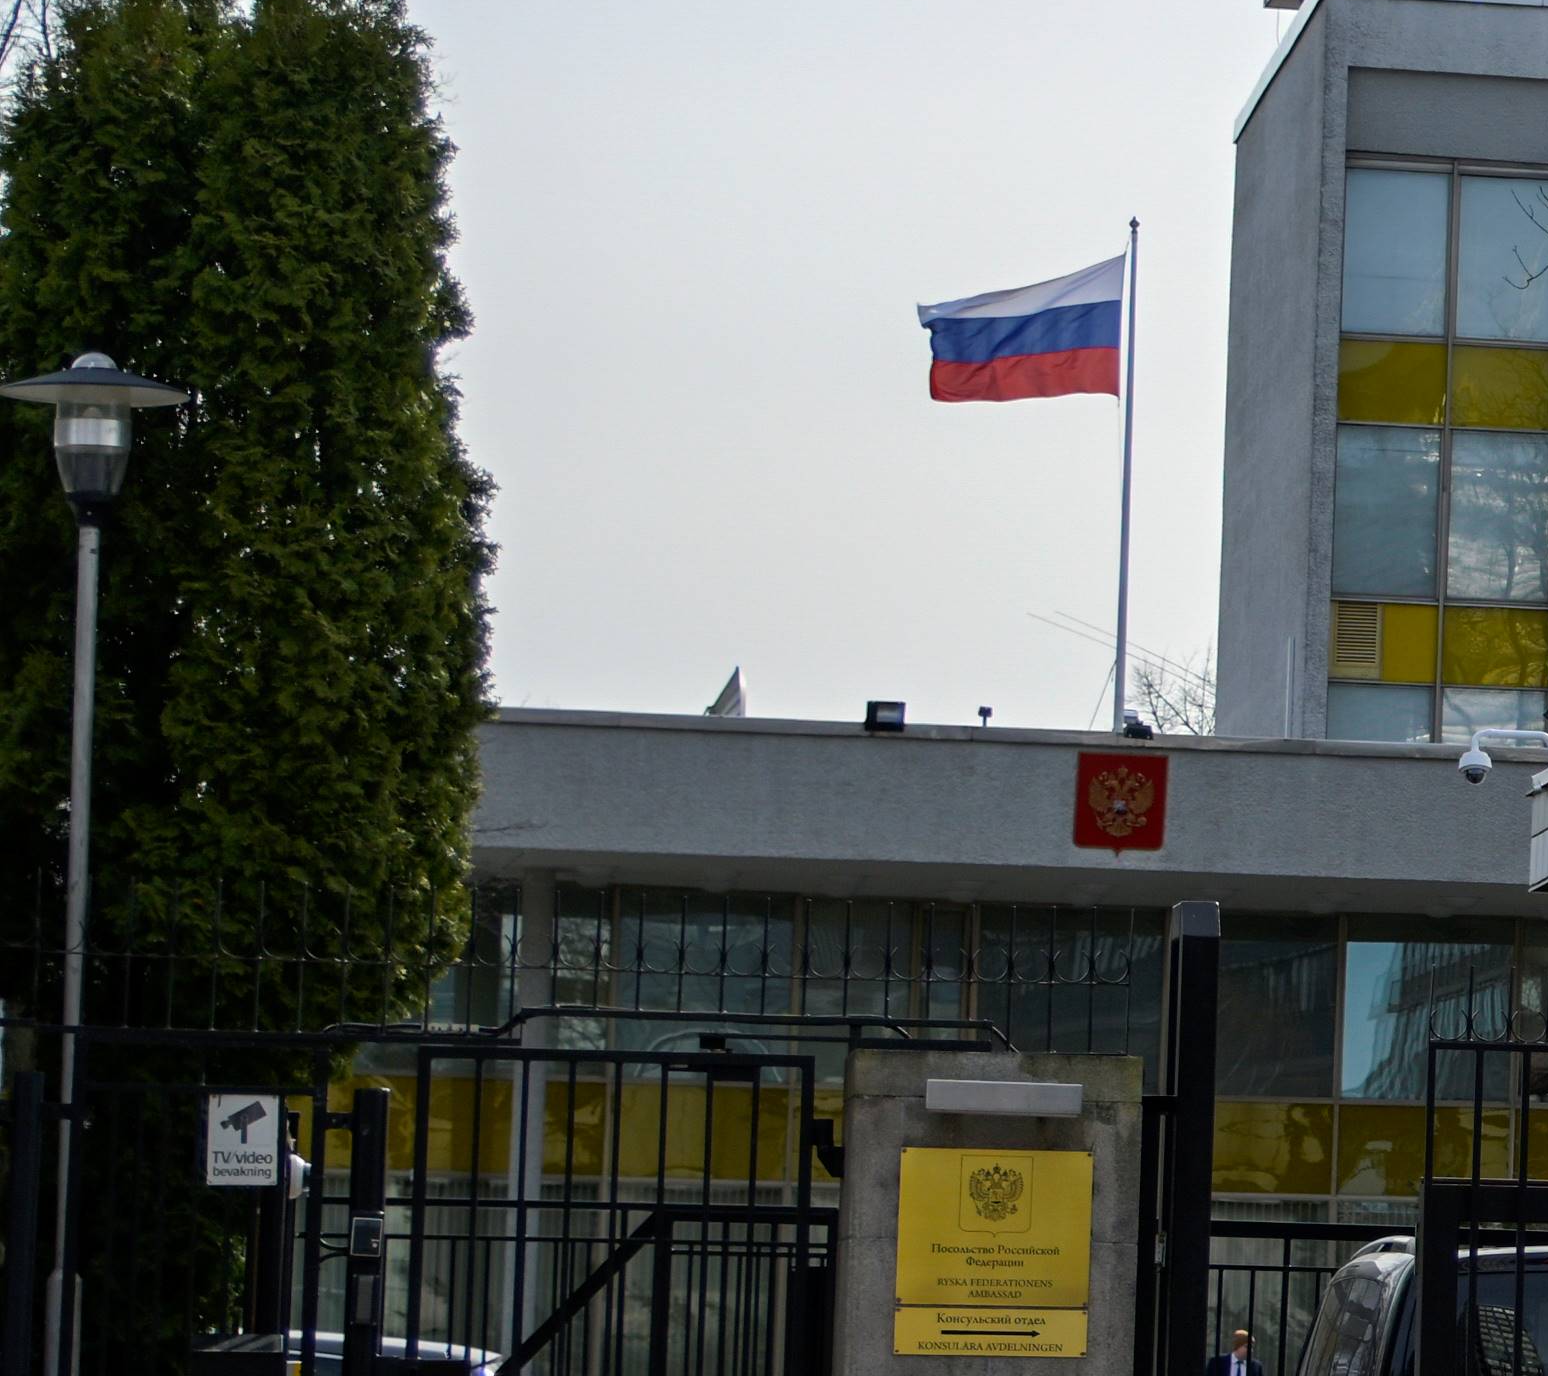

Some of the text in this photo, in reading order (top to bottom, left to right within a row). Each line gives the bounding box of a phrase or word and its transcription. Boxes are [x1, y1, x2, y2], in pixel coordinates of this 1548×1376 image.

[211, 1150, 273, 1164] TV/video
[212, 1167, 272, 1179] bevakning
[931, 1243, 1060, 1256] Посольство Российской
[965, 1256, 1024, 1269] Федерации
[937, 1278, 1053, 1288] RYSKA FEDERATIONENS
[967, 1290, 1022, 1299] AMBASSAD
[936, 1312, 1046, 1327] Консульский отдел
[985, 1342, 1063, 1352] AVDELNINGEN
